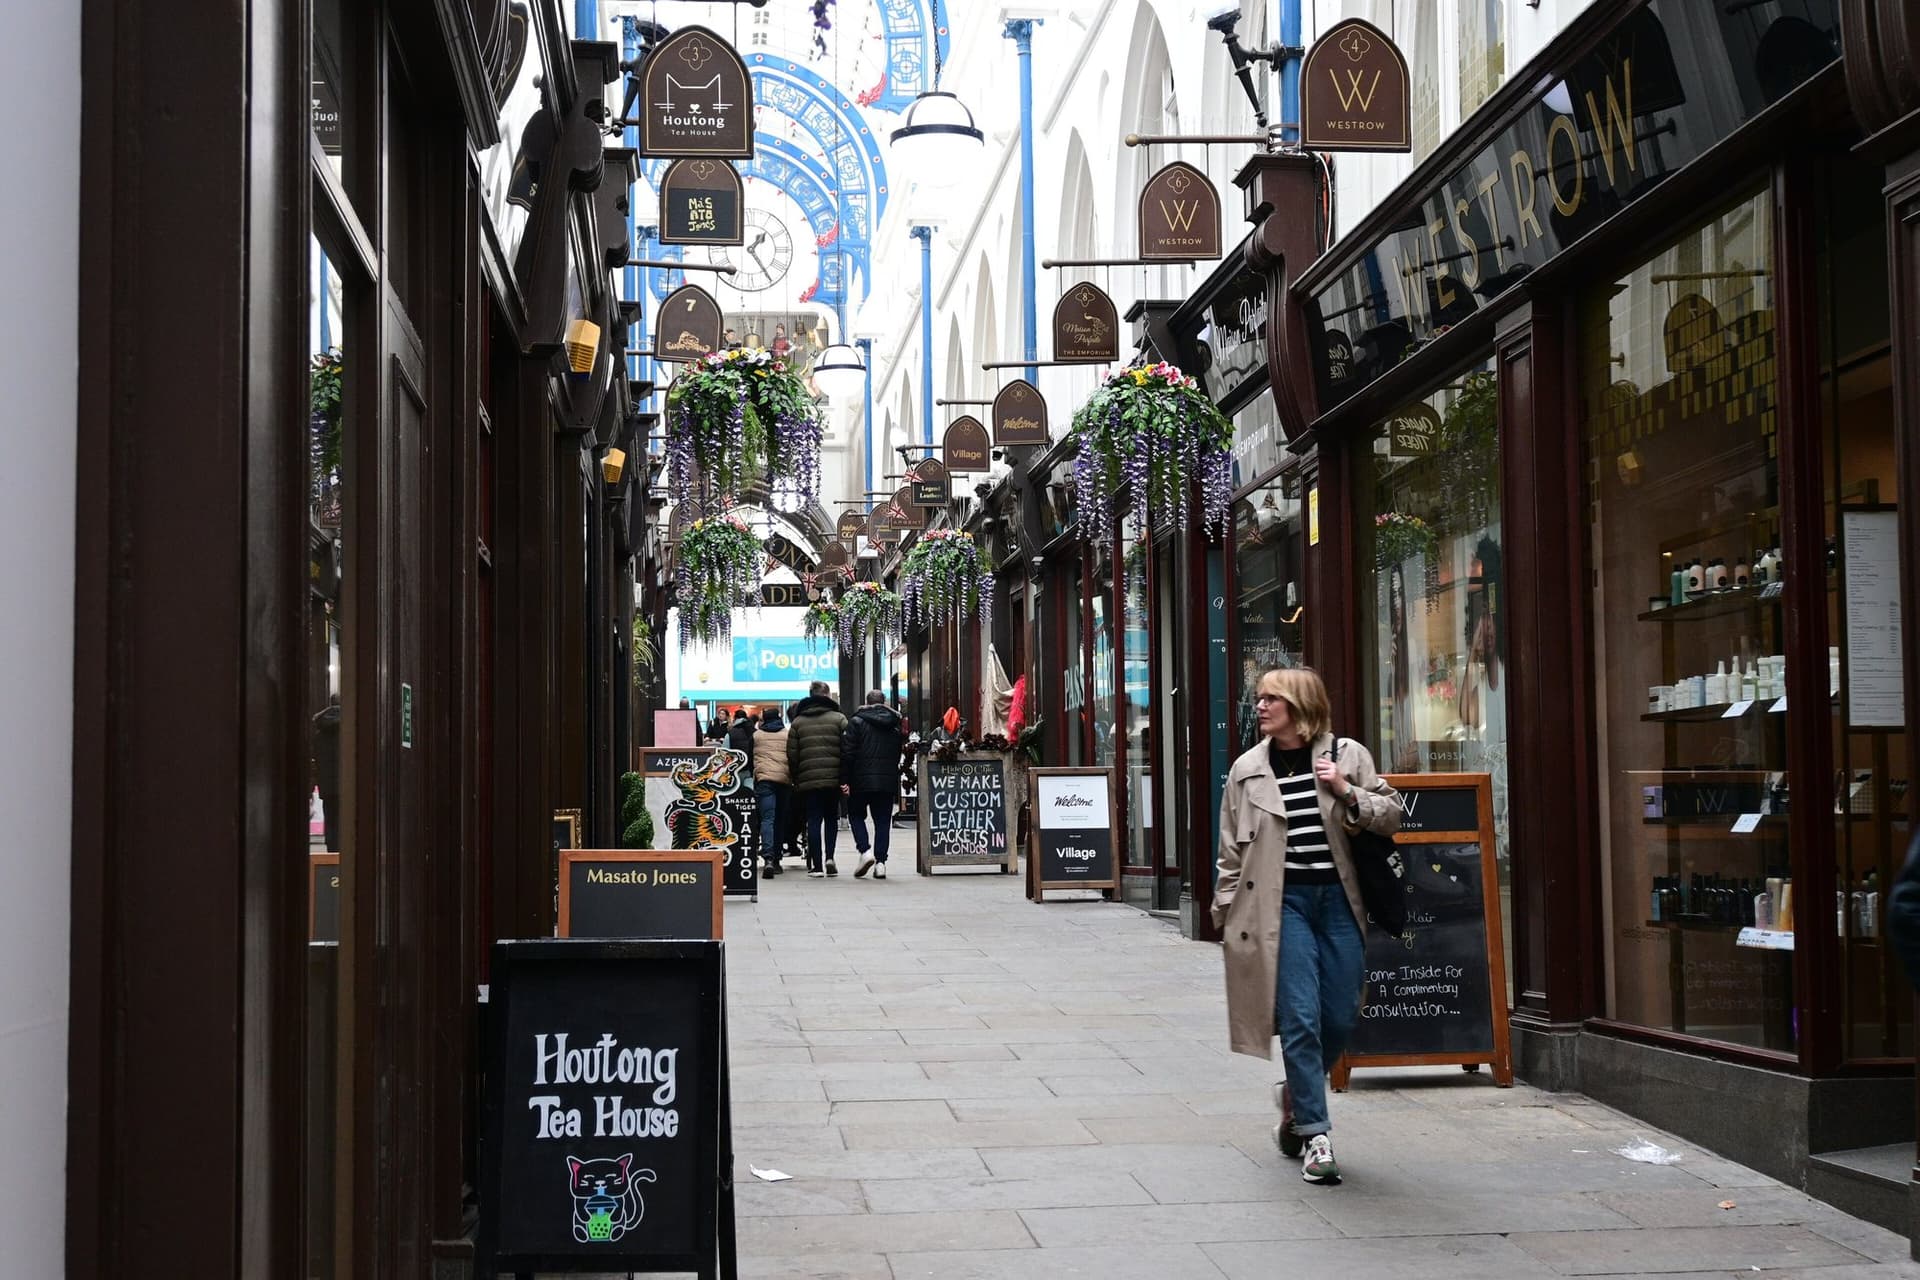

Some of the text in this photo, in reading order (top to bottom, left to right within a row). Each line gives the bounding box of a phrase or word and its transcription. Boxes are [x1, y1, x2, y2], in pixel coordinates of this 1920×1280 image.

[692, 46, 699, 61] 3
[1351, 39, 1359, 53] 4
[1329, 68, 1381, 112] W
[663, 115, 725, 128] Houtong
[1327, 121, 1385, 130] WESTROW
[700, 161, 705, 172] 5
[1175, 176, 1182, 188] 6
[1392, 57, 1636, 333] WESTROW
[1160, 199, 1198, 232] W
[1082, 292, 1088, 301] 8
[686, 299, 697, 311] 7
[952, 449, 982, 460] Village
[931, 774, 1001, 789] WE MAKE
[750, 796, 756, 804] &
[934, 791, 1001, 809] CUSTOM
[1054, 793, 1094, 808] Welcome
[930, 809, 996, 832] LEATHER
[740, 811, 752, 880] TATTOO
[932, 829, 1005, 848] JACKETS IN
[944, 842, 988, 855] LONDON
[1055, 847, 1097, 861] Village
[586, 868, 697, 887] Masato Jones
[1399, 965, 1442, 980] Inside
[1380, 984, 1387, 998] A
[533, 1032, 679, 1105] Houtong
[528, 1095, 680, 1139] Tea House
